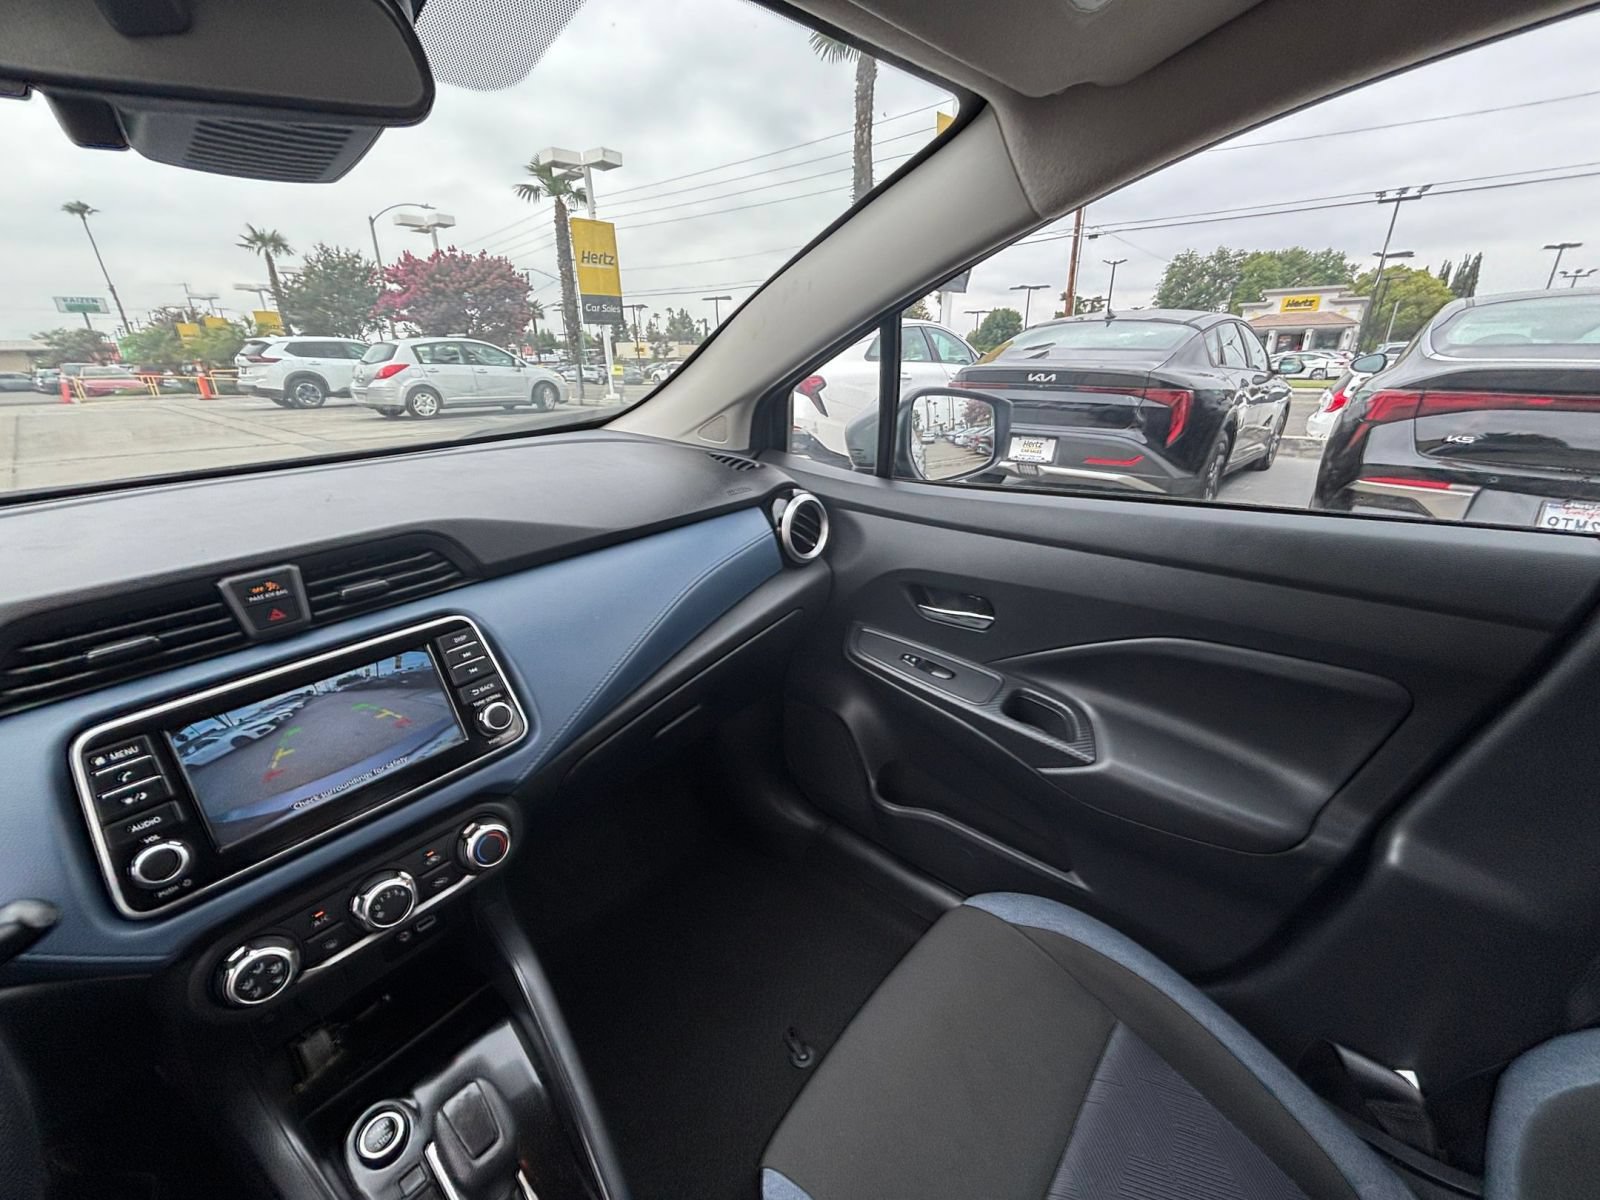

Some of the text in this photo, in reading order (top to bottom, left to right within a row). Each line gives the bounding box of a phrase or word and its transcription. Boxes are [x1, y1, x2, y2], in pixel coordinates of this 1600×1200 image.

[581, 250, 615, 266] Hertz
[585, 303, 621, 313] Car Sales
[1022, 440, 1044, 449] Hertz
[480, 683, 494, 692] BACK
[109, 746, 139, 761] MENU
[293, 795, 320, 811] Check
[320, 773, 373, 799] surroundings
[131, 816, 162, 833] AUDIO
[143, 834, 160, 844] VOL
